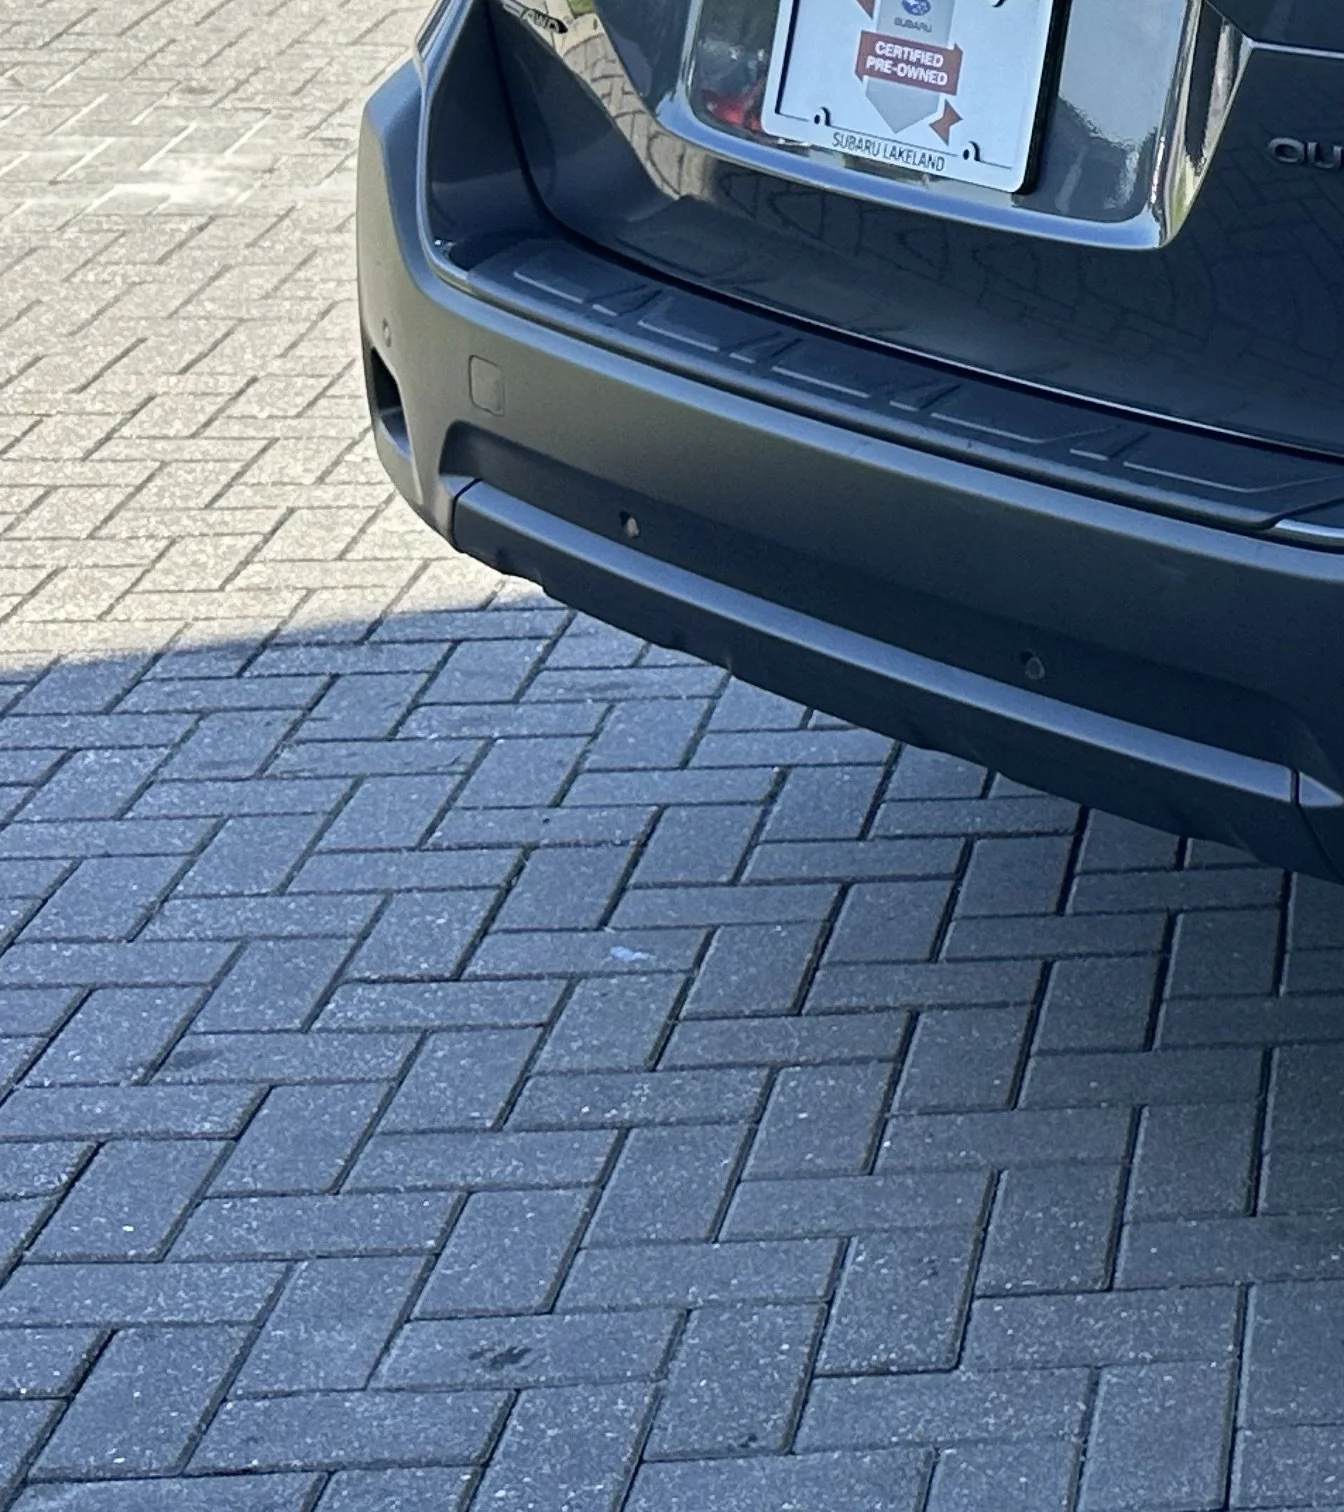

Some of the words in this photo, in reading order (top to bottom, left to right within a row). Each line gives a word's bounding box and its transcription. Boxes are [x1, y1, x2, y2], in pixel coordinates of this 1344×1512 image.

[893, 16, 933, 33] SUBARU
[874, 40, 944, 67] CERTIFIED
[865, 55, 949, 86] PRE-OWNED
[831, 131, 881, 158] SUBARU
[883, 144, 946, 172] LAKELAND
